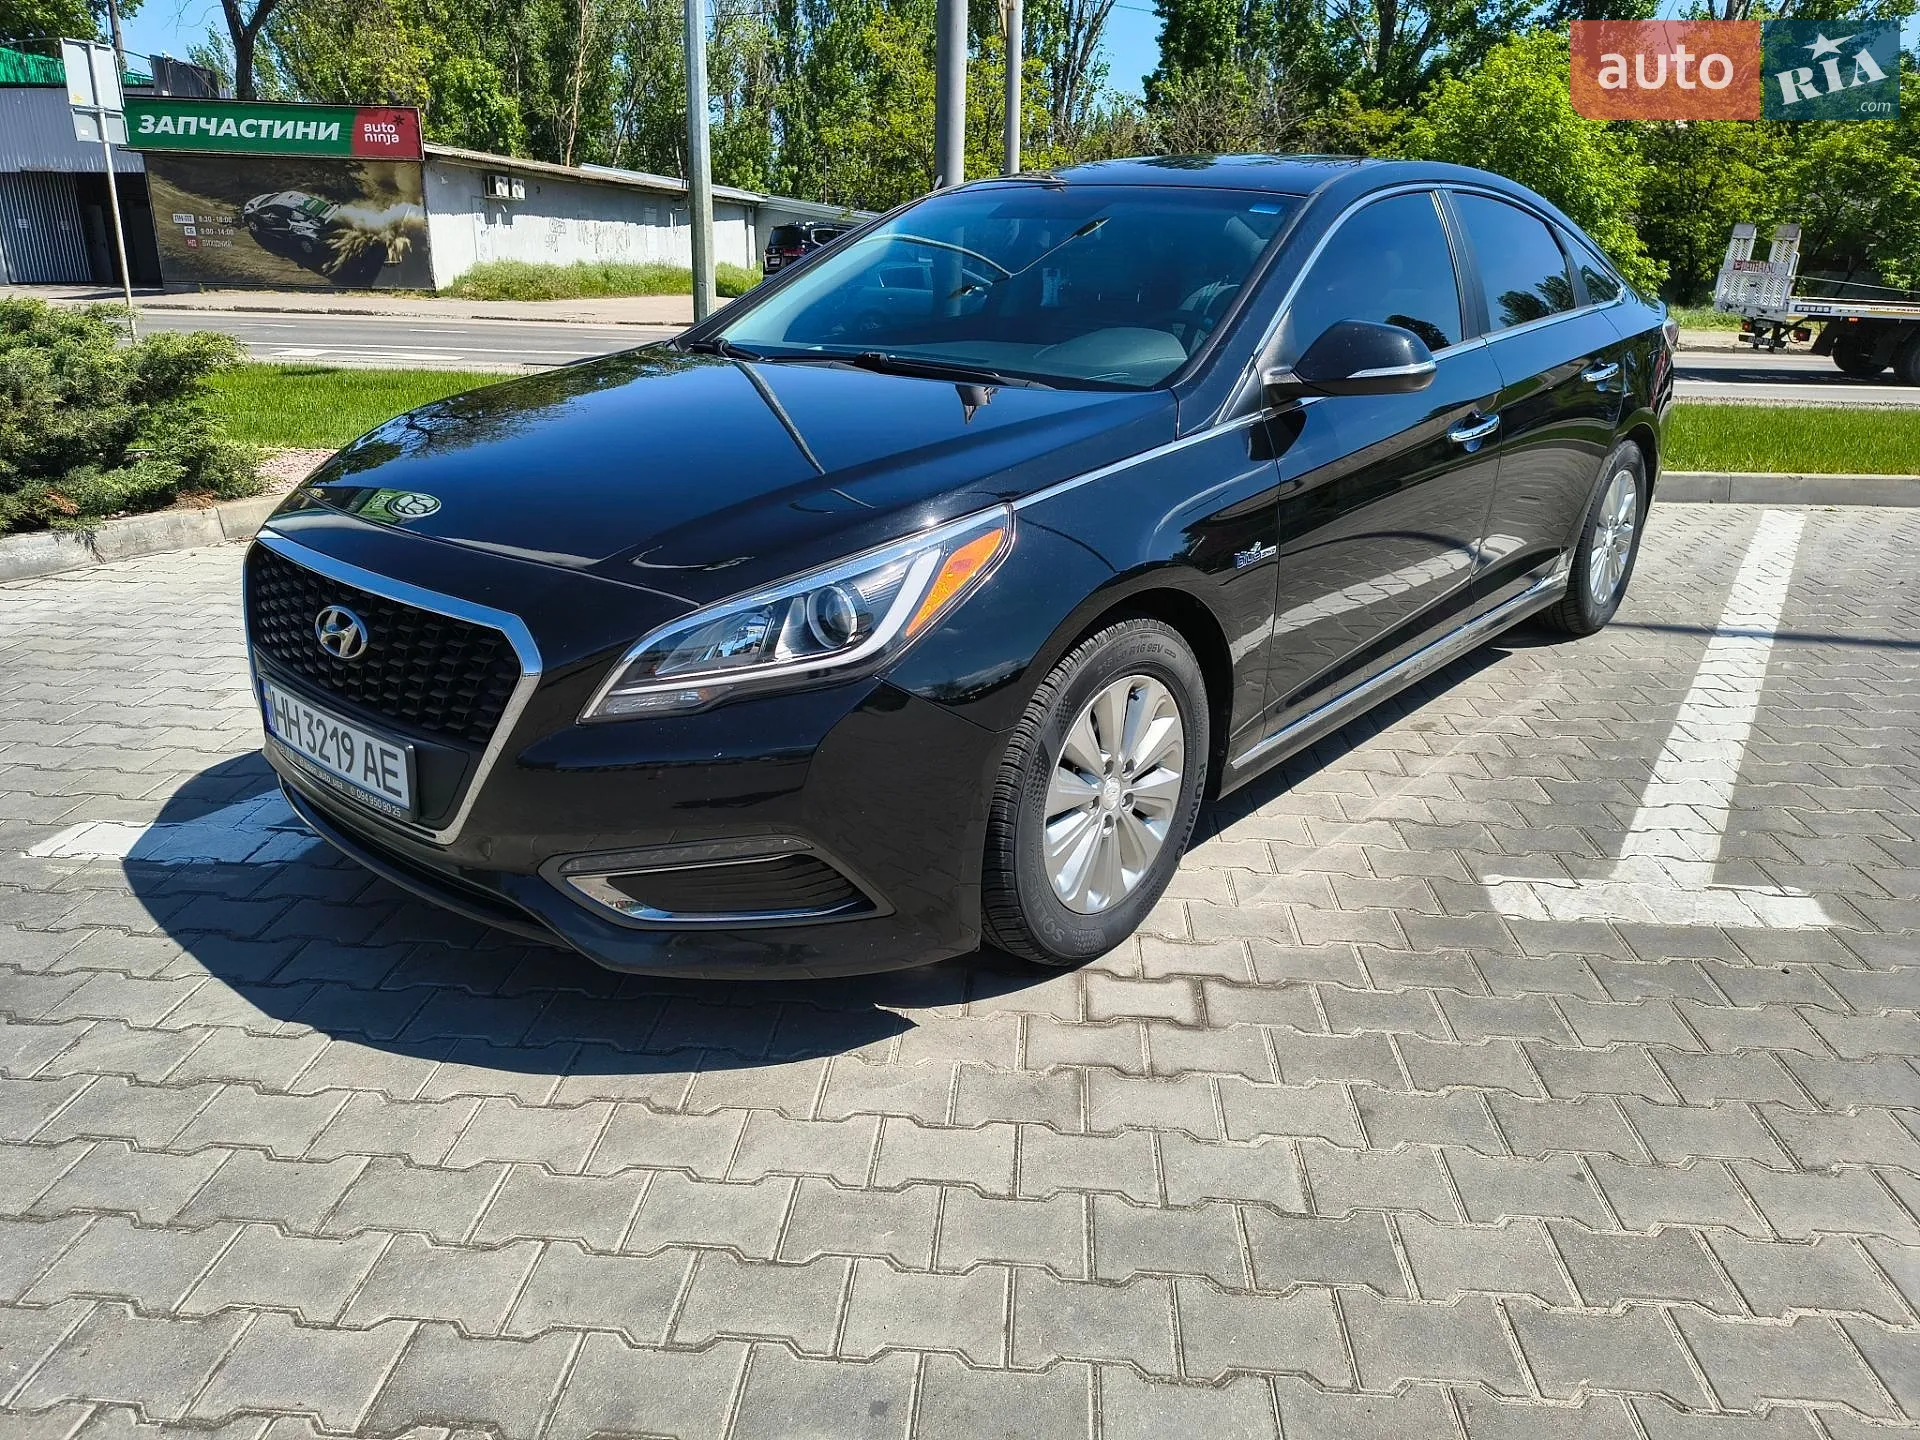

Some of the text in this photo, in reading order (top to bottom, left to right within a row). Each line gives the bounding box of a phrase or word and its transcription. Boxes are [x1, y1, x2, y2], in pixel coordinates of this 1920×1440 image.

[138, 114, 340, 141] ЗАПЧАСТИНИ
[364, 121, 396, 134] auto
[364, 132, 400, 145] ninja
[272, 691, 403, 799] HH 3219 AE
